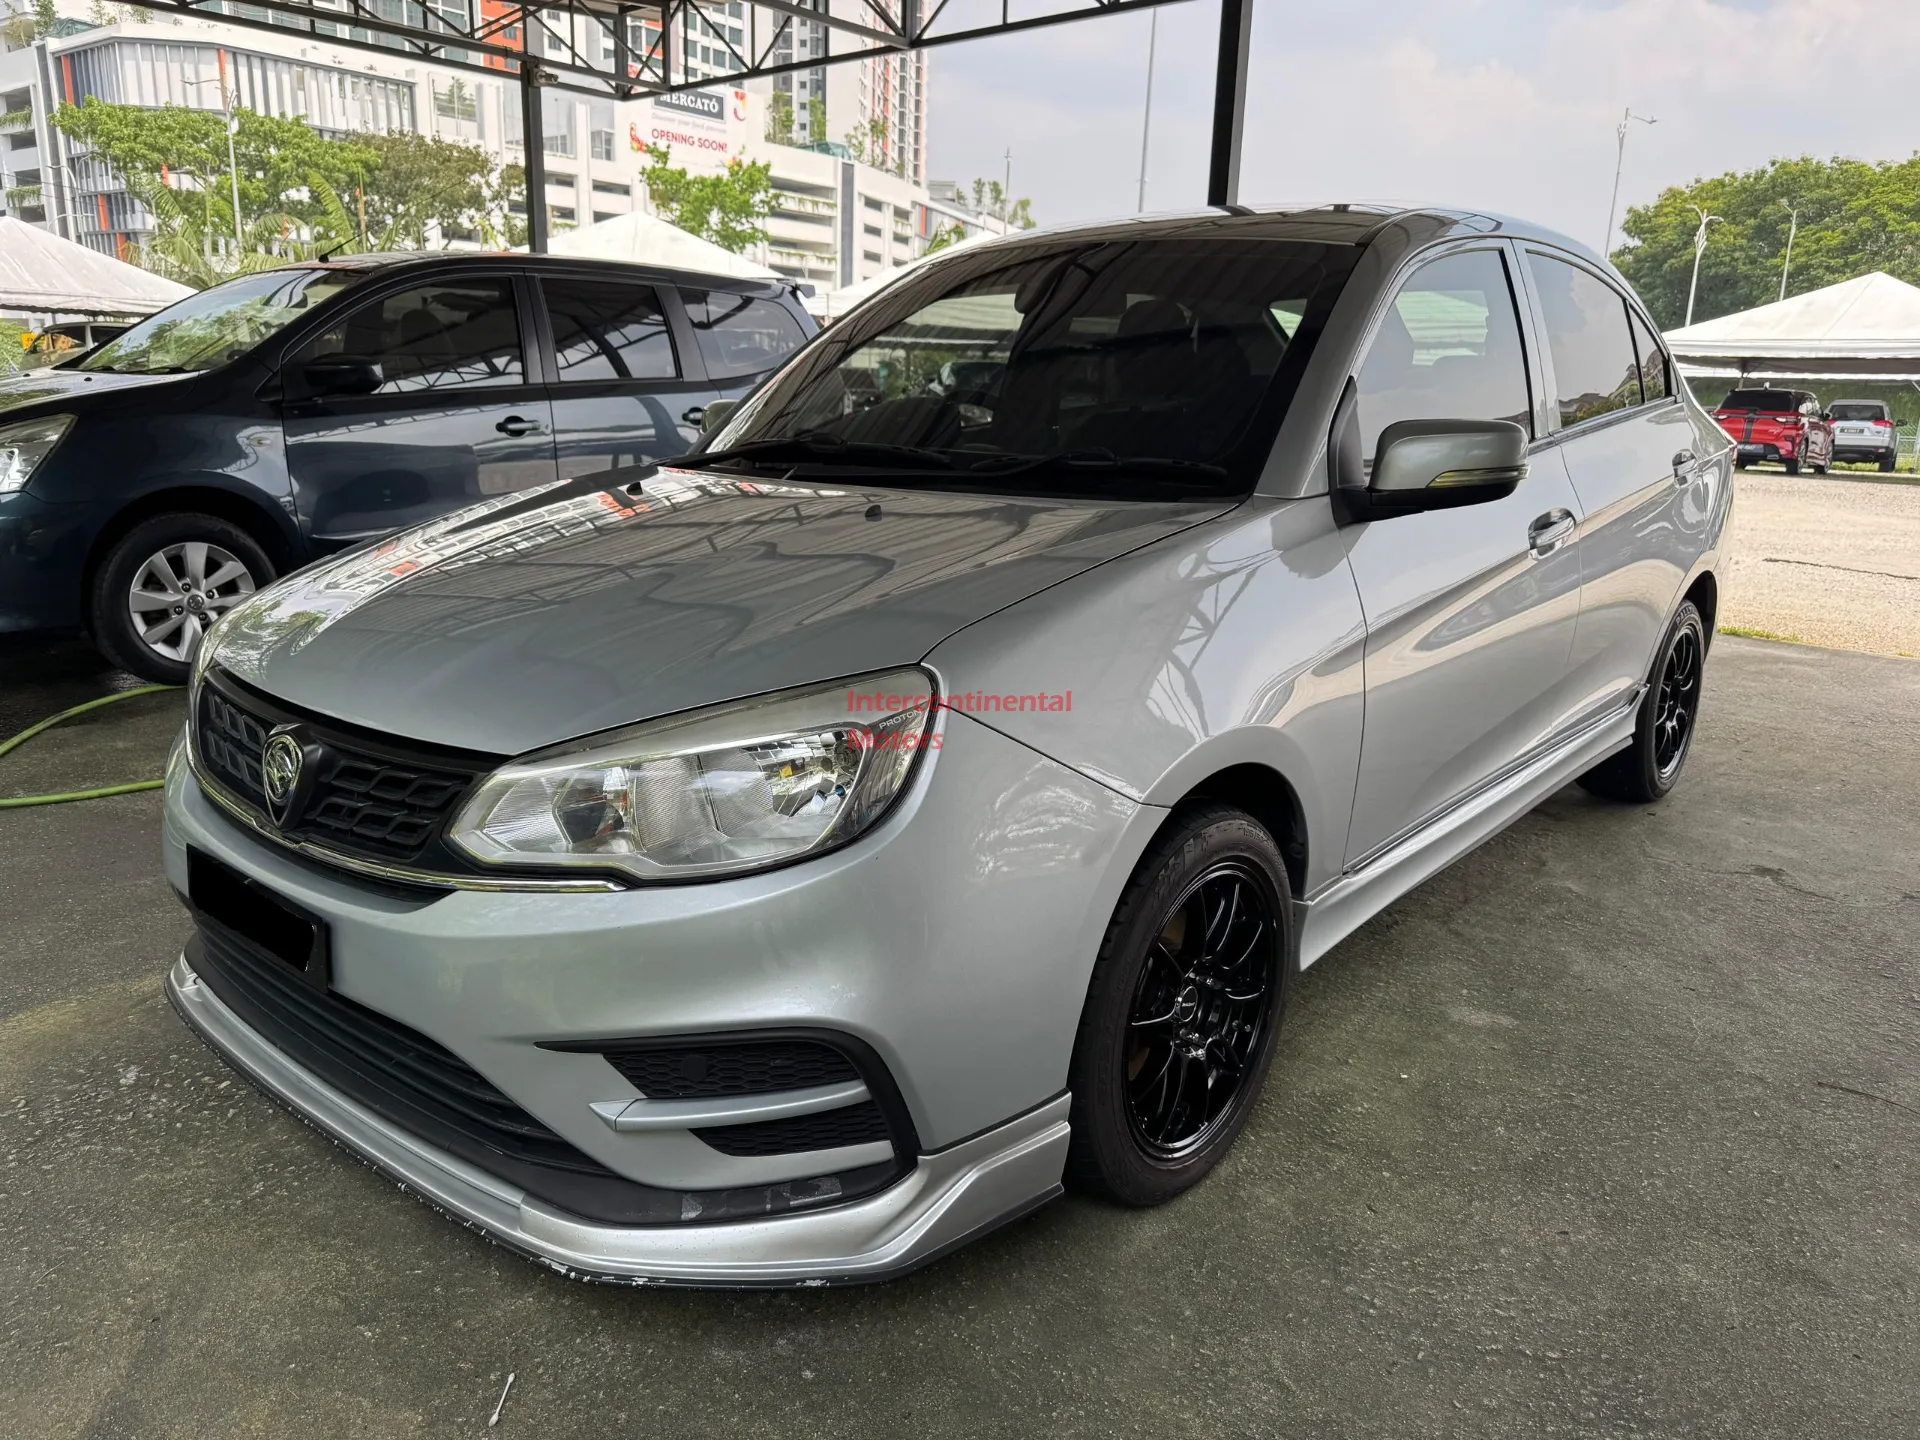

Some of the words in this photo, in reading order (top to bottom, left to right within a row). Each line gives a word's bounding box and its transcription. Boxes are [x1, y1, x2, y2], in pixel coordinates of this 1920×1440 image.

[652, 129, 695, 146] OPENING
[698, 138, 727, 152] SOON!
[879, 709, 922, 729] PROTON
